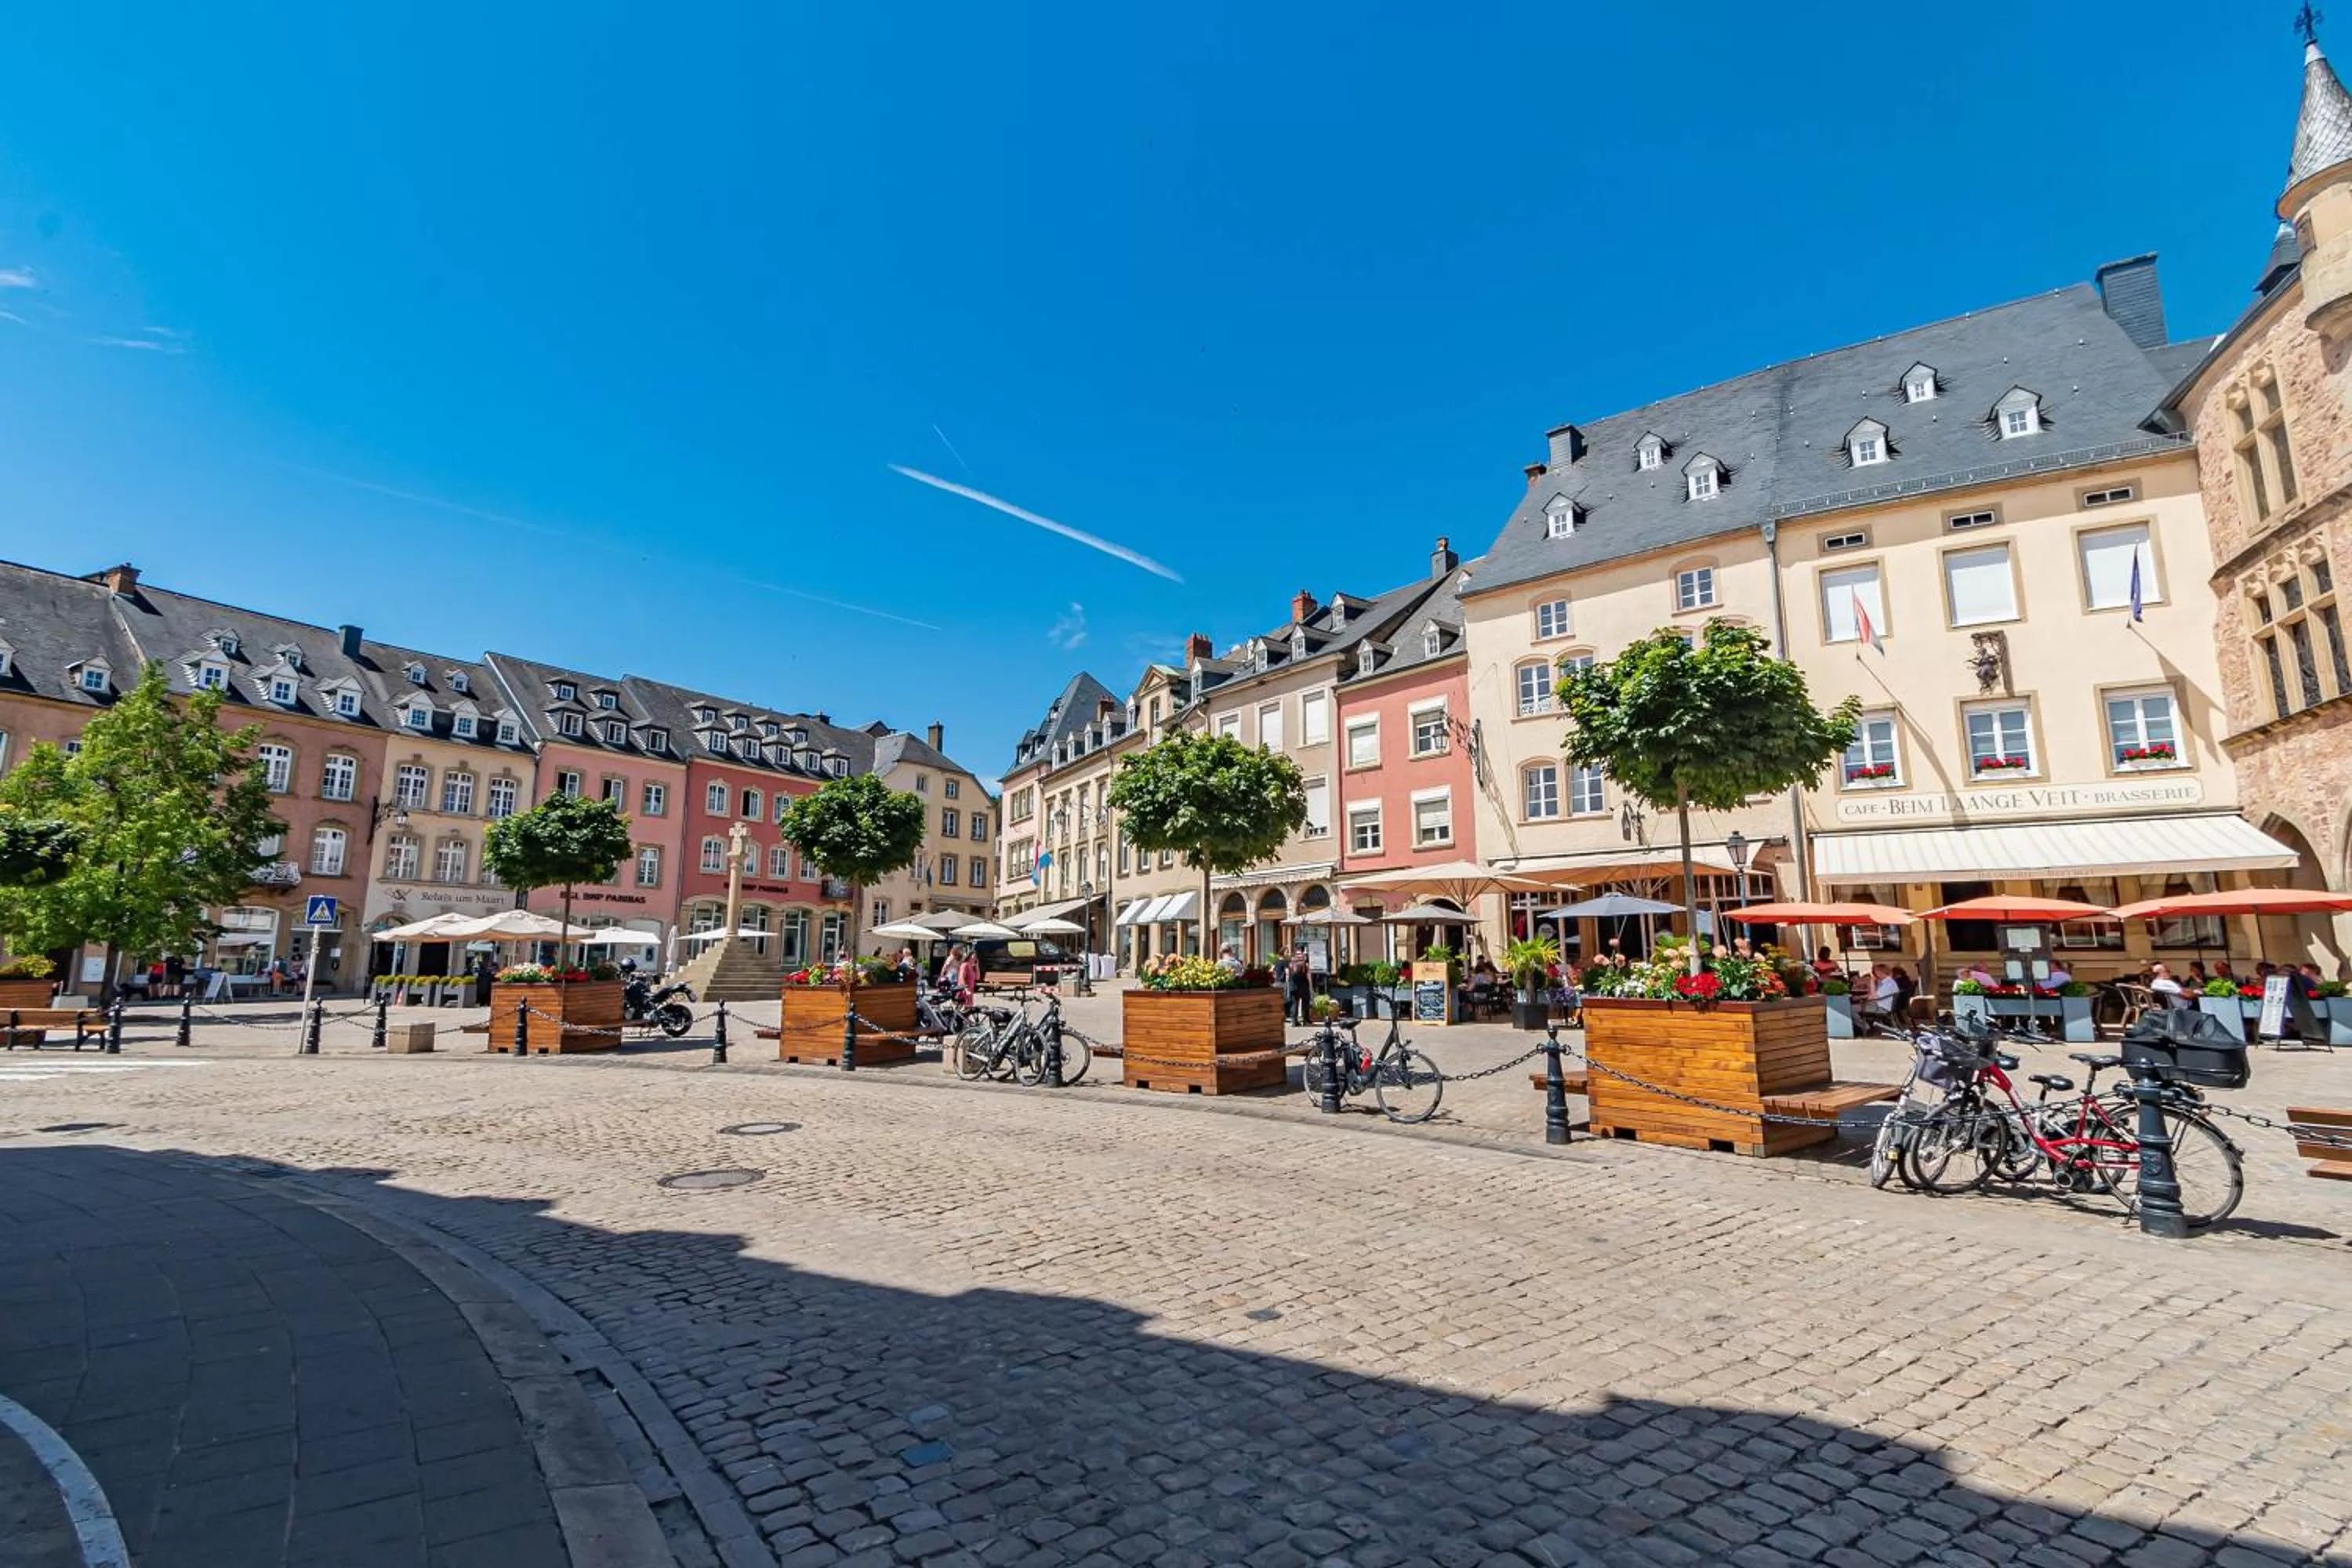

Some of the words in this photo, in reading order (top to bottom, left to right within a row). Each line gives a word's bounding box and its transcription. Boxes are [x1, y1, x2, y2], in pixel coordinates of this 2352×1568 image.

[1889, 798, 1933, 815] BEIM
[1941, 793, 2023, 812] LAANGE
[2029, 789, 2081, 807] VEIT
[2095, 786, 2197, 804] BRASSERIE
